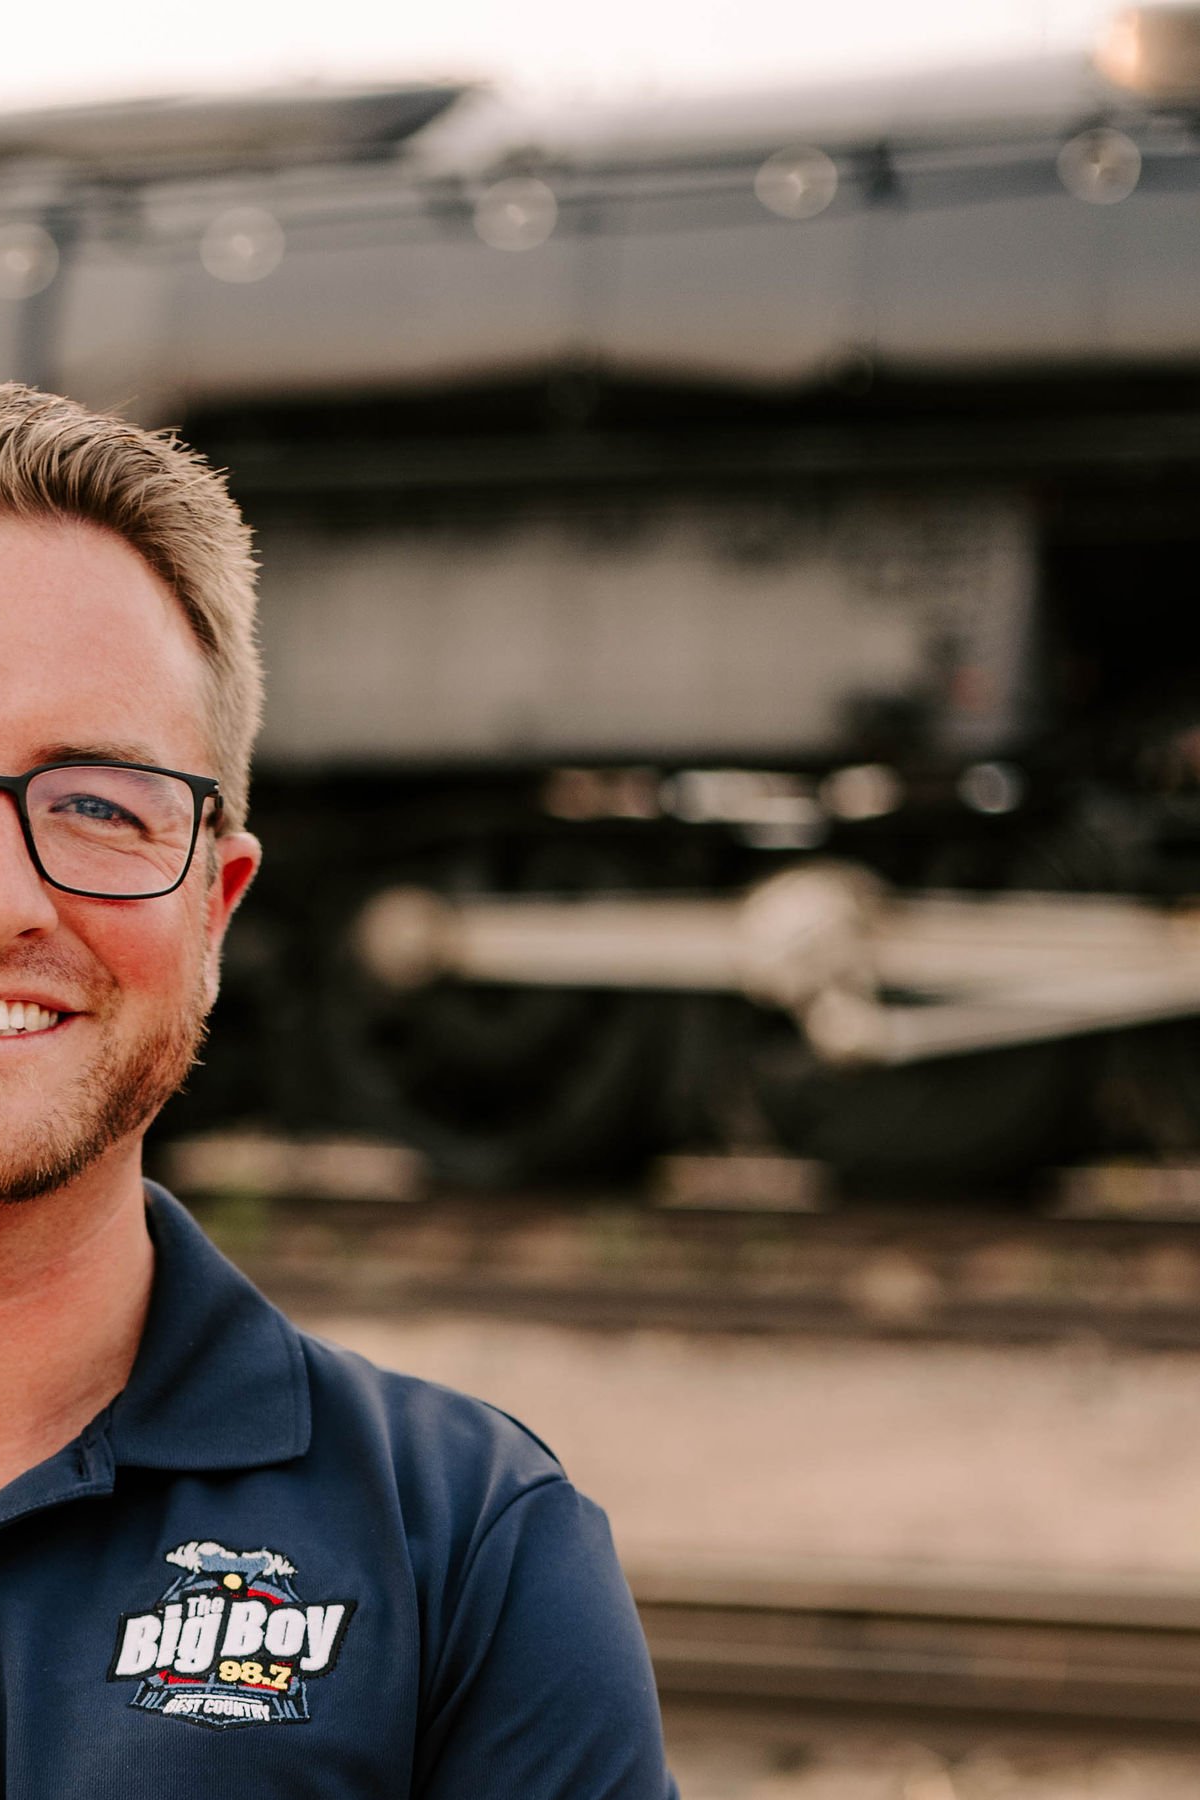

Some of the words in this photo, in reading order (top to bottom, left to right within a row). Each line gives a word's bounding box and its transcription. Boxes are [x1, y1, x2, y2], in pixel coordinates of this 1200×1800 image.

[187, 1594, 225, 1618] The
[115, 1603, 222, 1676] Big
[220, 1599, 346, 1672] Boy
[219, 1660, 292, 1690] 98.7
[162, 1698, 203, 1714] BEST
[203, 1699, 270, 1722] COUNTRY
